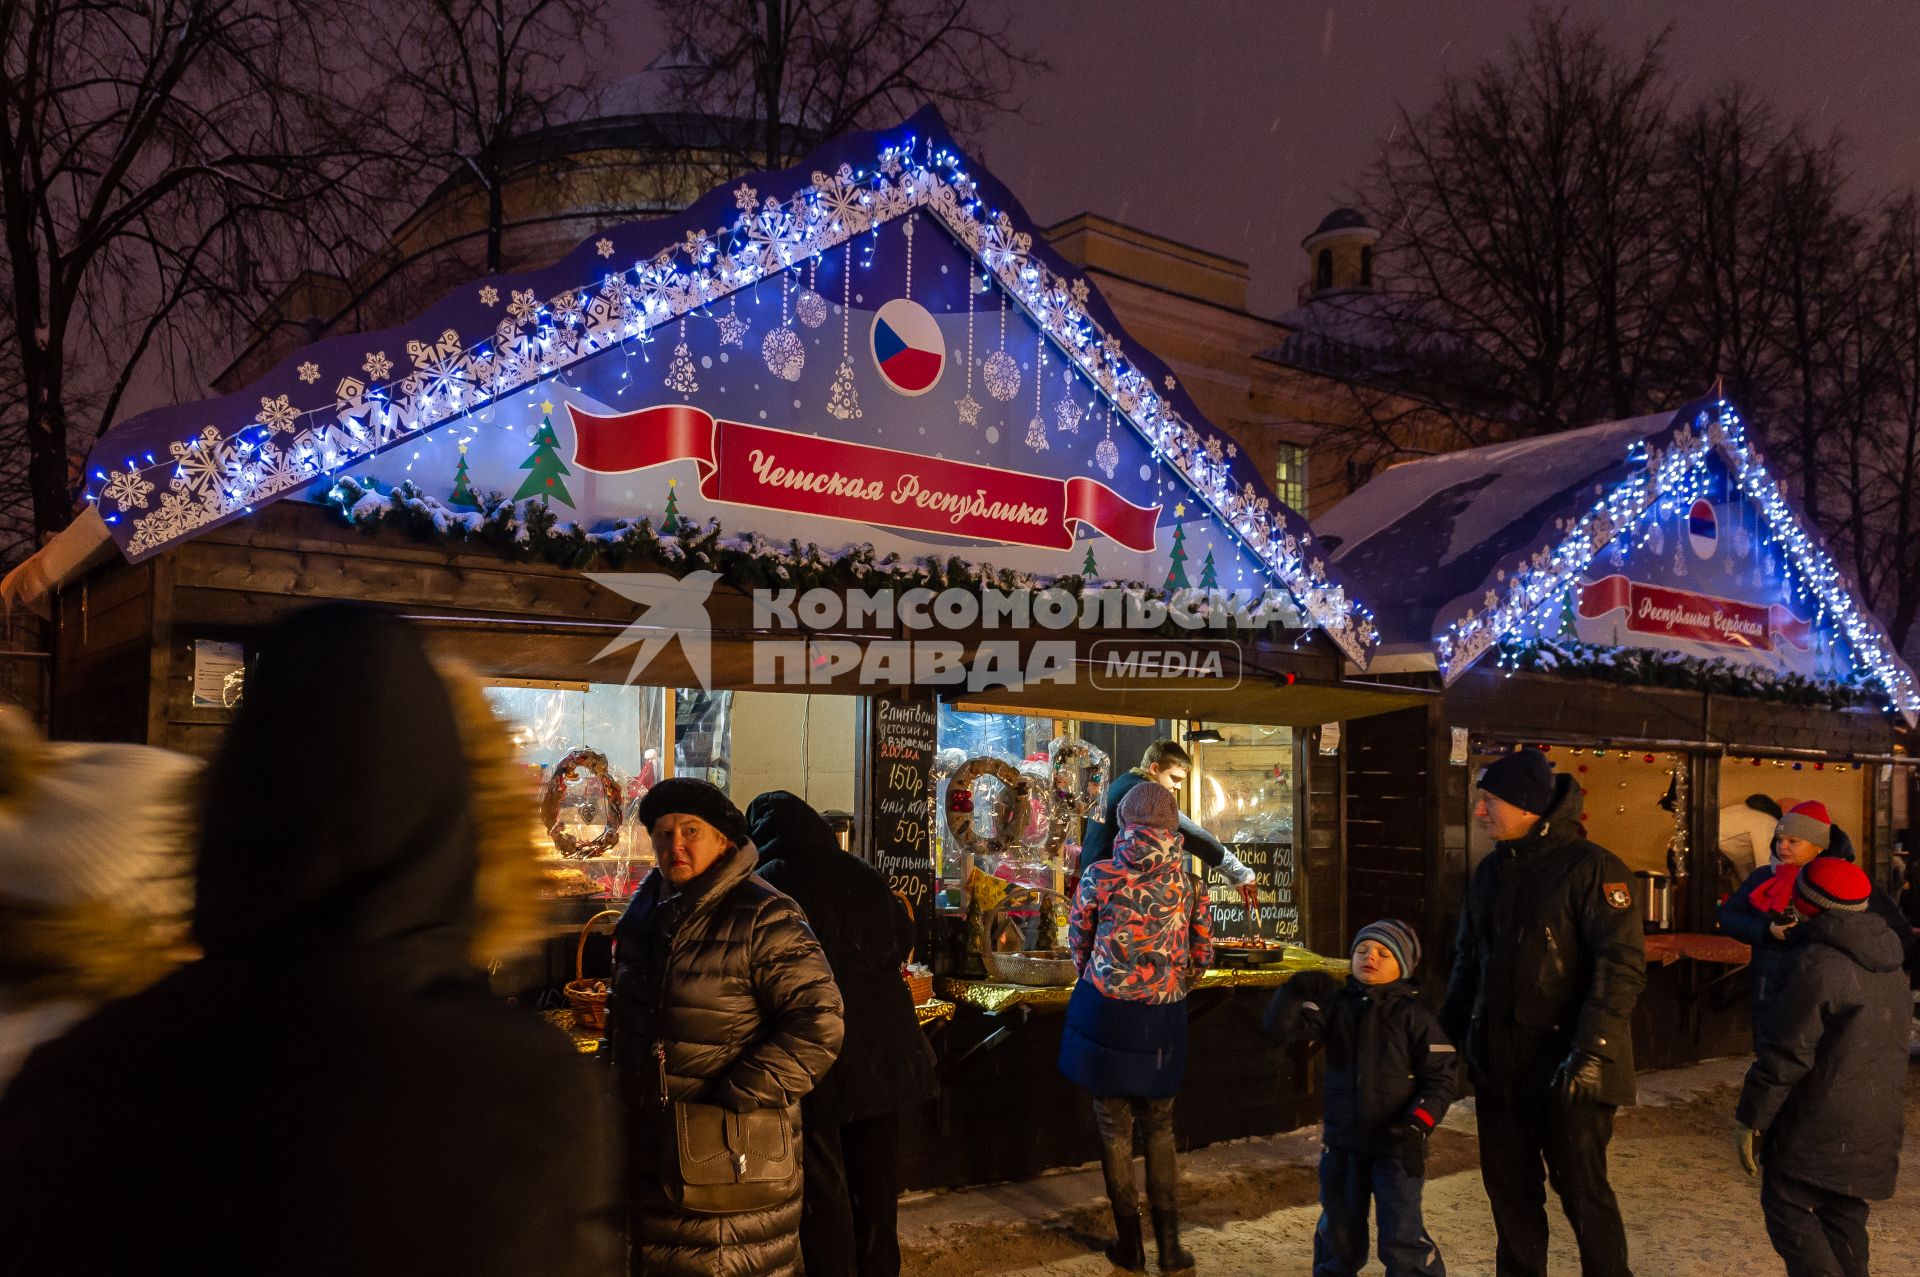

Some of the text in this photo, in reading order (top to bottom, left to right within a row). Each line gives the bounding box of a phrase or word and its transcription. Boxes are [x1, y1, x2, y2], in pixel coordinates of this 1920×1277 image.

[748, 449, 1049, 526] Чешская Республика
[1639, 596, 1764, 638] Республика Сербская
[888, 763, 923, 798] 150р
[893, 819, 926, 851] 50р
[877, 849, 930, 876] Трдельни
[888, 875, 928, 906] 220р
[1209, 904, 1245, 932] Парек
[1275, 920, 1300, 938] 120р
